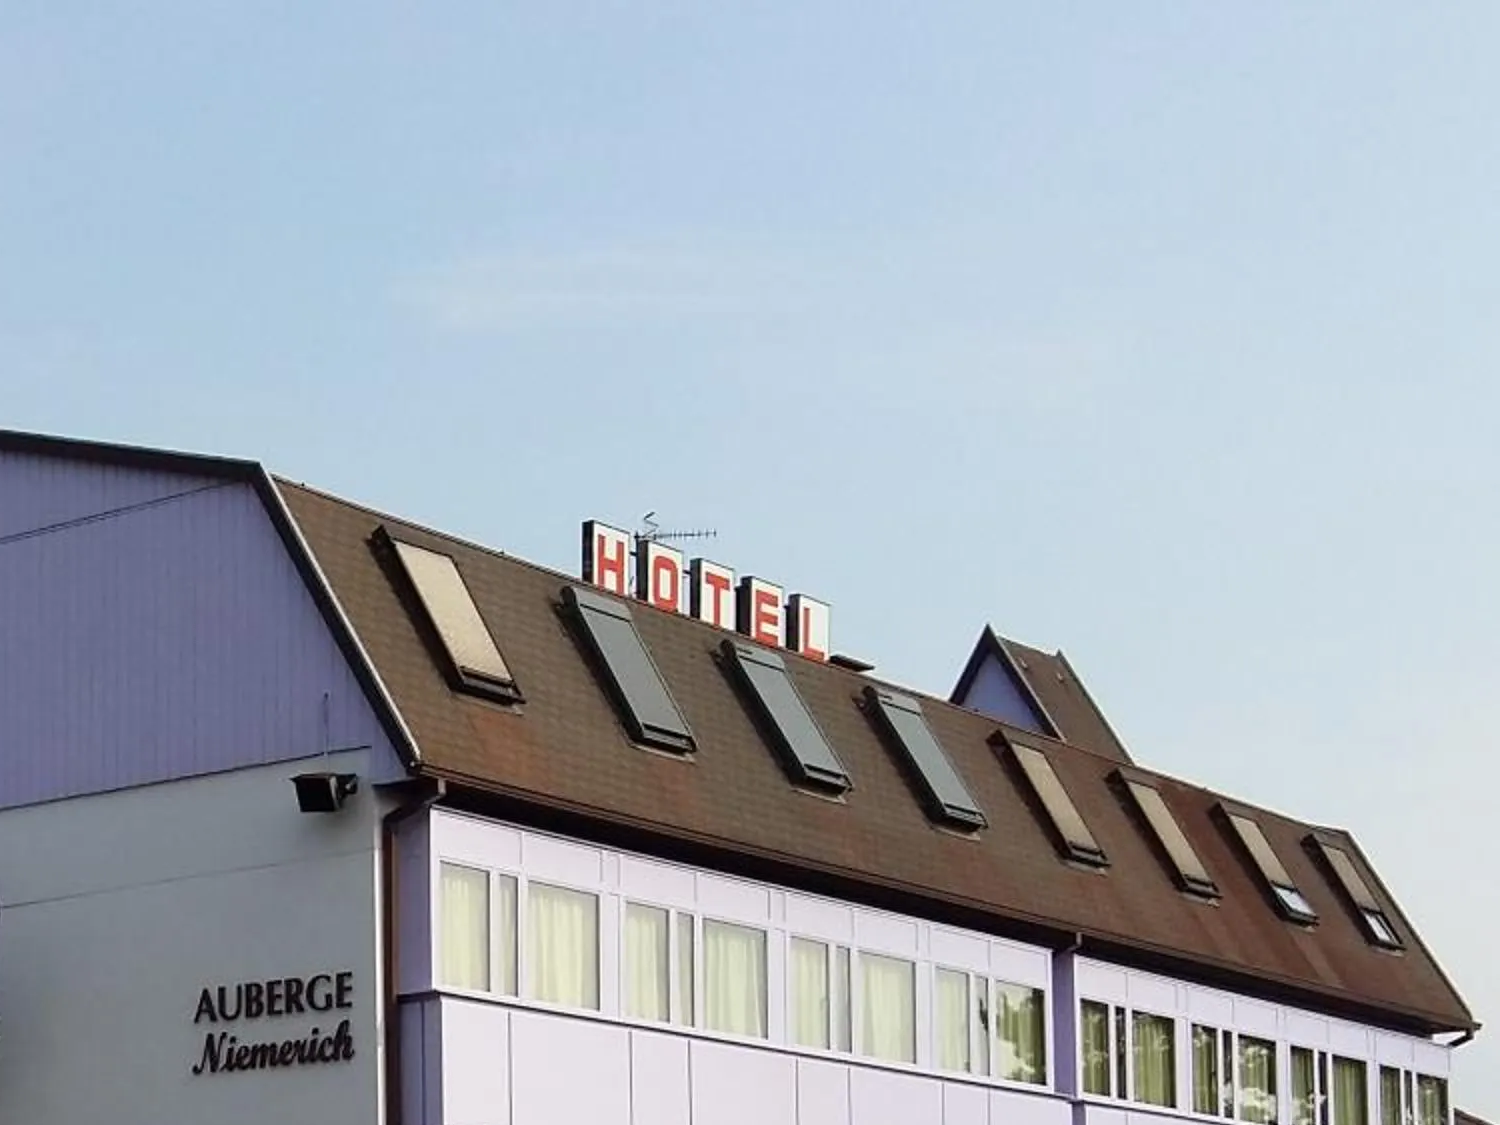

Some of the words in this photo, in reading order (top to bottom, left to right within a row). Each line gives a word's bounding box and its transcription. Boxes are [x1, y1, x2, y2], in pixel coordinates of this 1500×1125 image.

[598, 533, 825, 662] HOTEL
[194, 971, 353, 1023] AUBERGE
[192, 1019, 355, 1075] Niemerich
